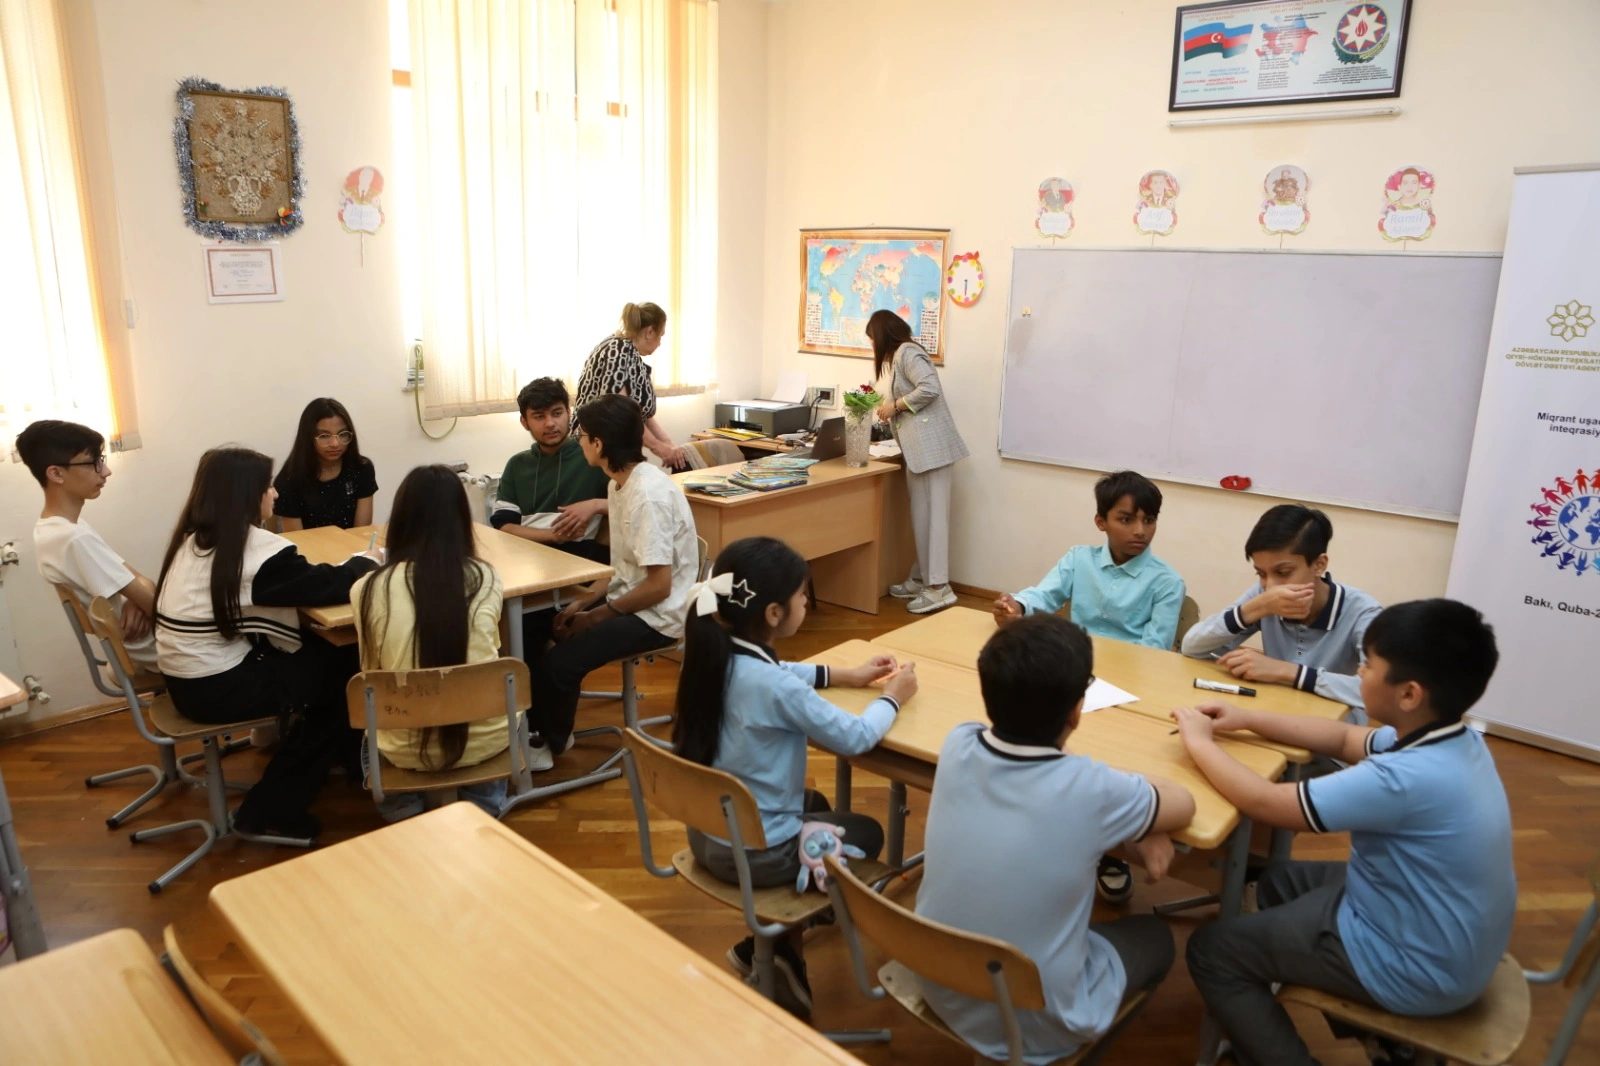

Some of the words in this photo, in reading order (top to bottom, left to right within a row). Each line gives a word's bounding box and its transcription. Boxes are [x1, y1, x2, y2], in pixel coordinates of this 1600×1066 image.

[1390, 212, 1424, 223] Ramil
[1511, 347, 1560, 355] AZƏRBAYCAN
[1515, 360, 1544, 369] DÖVLƏT
[1537, 412, 1576, 424] Miqrant
[1524, 595, 1553, 610] Bakı,
